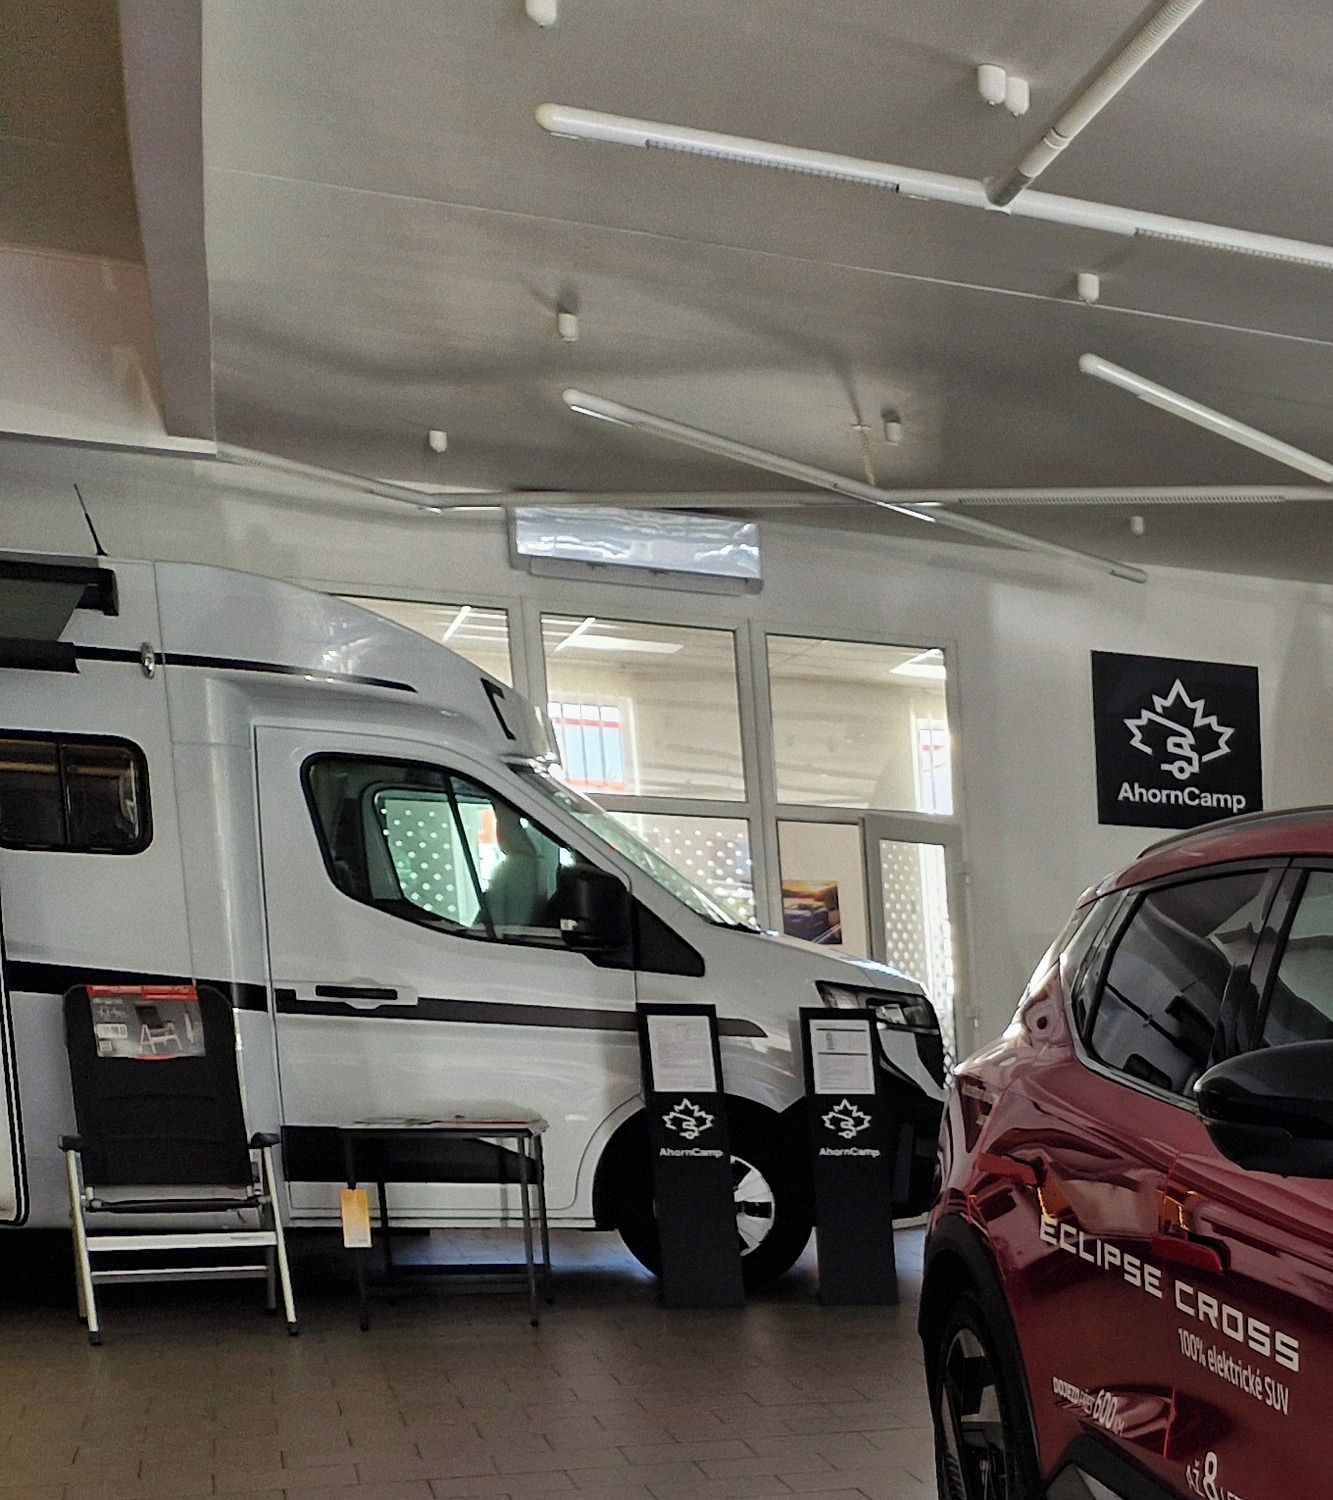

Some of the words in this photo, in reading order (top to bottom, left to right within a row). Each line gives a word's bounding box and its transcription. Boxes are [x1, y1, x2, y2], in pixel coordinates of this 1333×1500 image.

[1117, 781, 1247, 813] AhornCamp
[659, 1147, 723, 1158] AhornCamp
[818, 1147, 881, 1158] AhornCamp
[1040, 1215, 1163, 1299] ECLIPSE
[1174, 1279, 1299, 1373] CROSS
[1178, 1327, 1206, 1367] 100%
[1207, 1345, 1262, 1400] elektrické
[1264, 1376, 1289, 1416] SUV
[1092, 1389, 1118, 1429] 600
